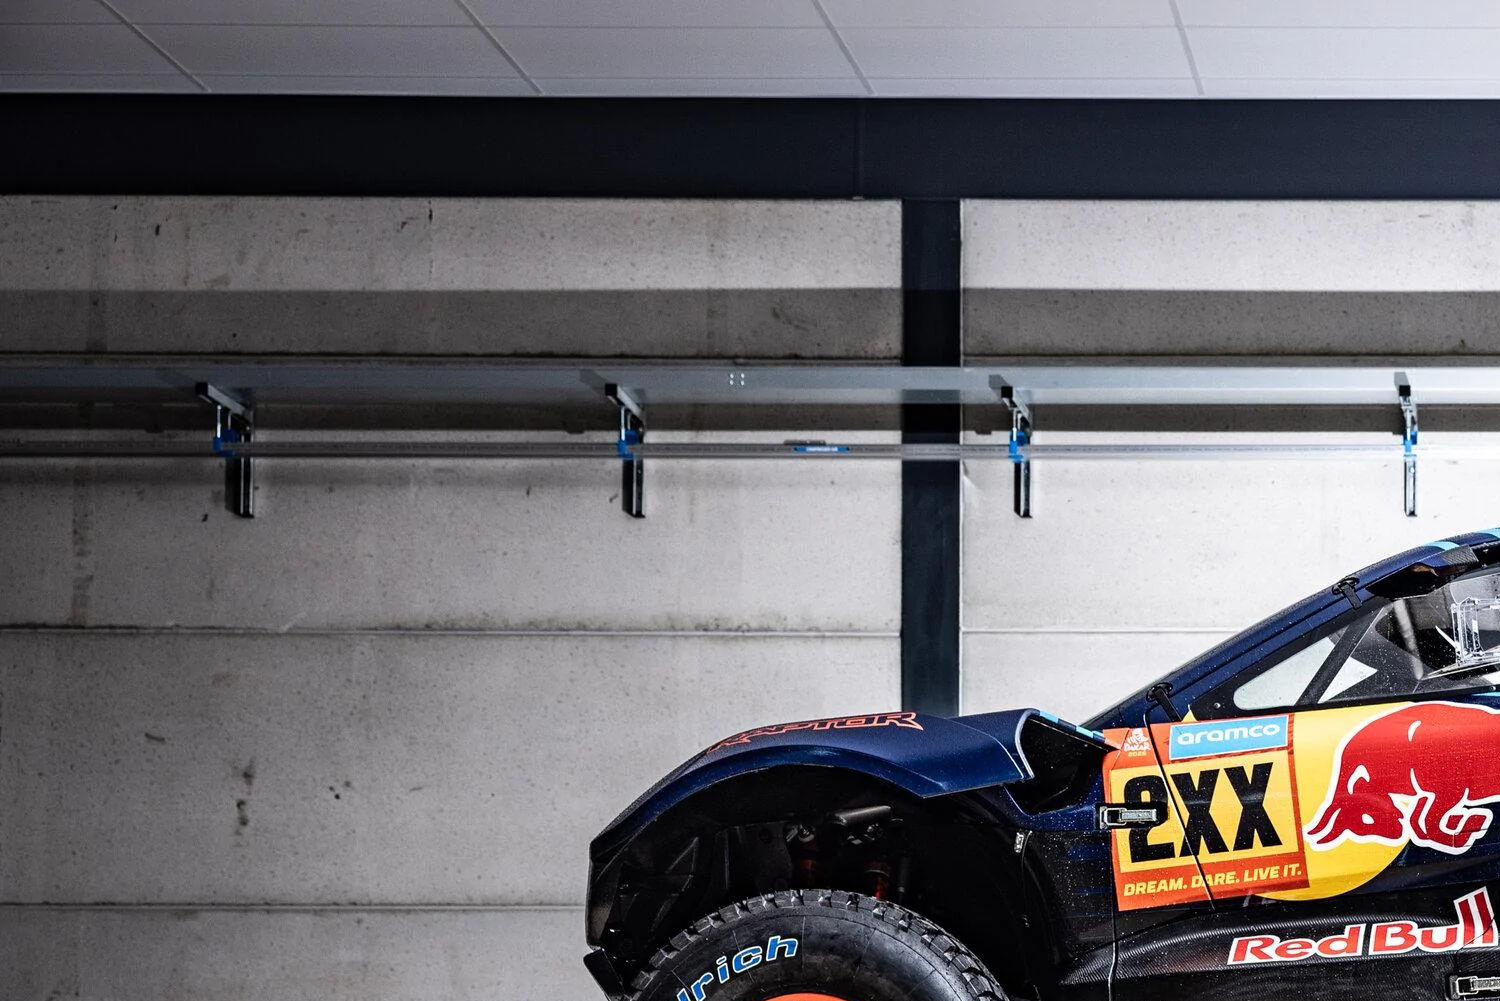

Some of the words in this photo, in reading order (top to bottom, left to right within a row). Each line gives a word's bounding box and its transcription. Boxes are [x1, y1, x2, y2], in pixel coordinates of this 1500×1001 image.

[1177, 723, 1281, 745] aramco
[1123, 761, 1284, 863] 2XX
[1123, 877, 1188, 897] DREAM.
[1191, 871, 1240, 888] DARE.
[1243, 865, 1280, 882] LIVE
[1283, 863, 1302, 877] IT.
[1229, 924, 1365, 964] Red
[1369, 887, 1498, 954] Bull
